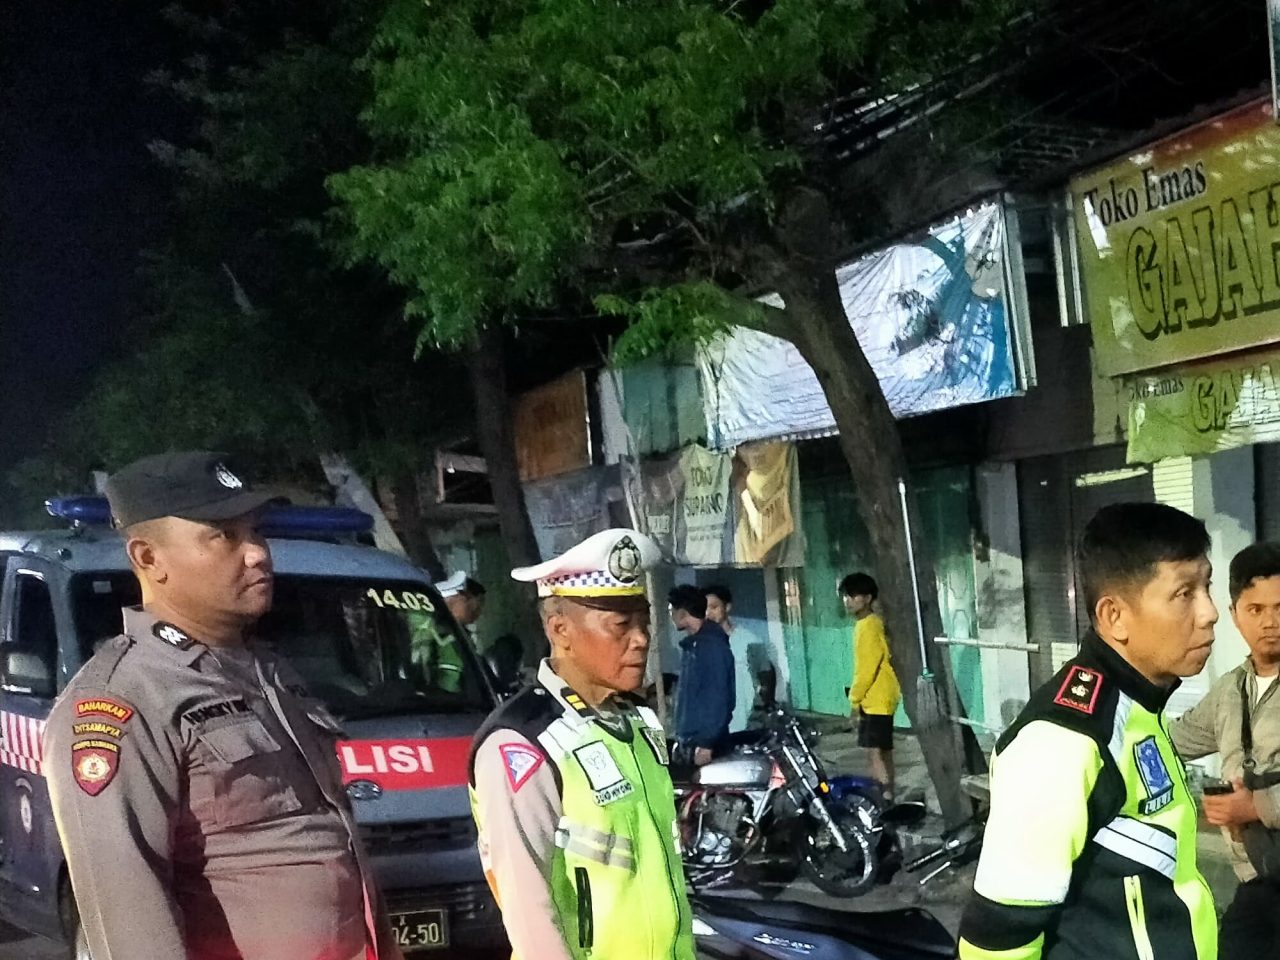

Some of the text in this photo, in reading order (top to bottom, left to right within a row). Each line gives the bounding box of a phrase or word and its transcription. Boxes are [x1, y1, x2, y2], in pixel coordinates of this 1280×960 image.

[1084, 160, 1207, 226] Toko Emas
[366, 587, 436, 613] 14.03
[337, 745, 435, 774] LISI
